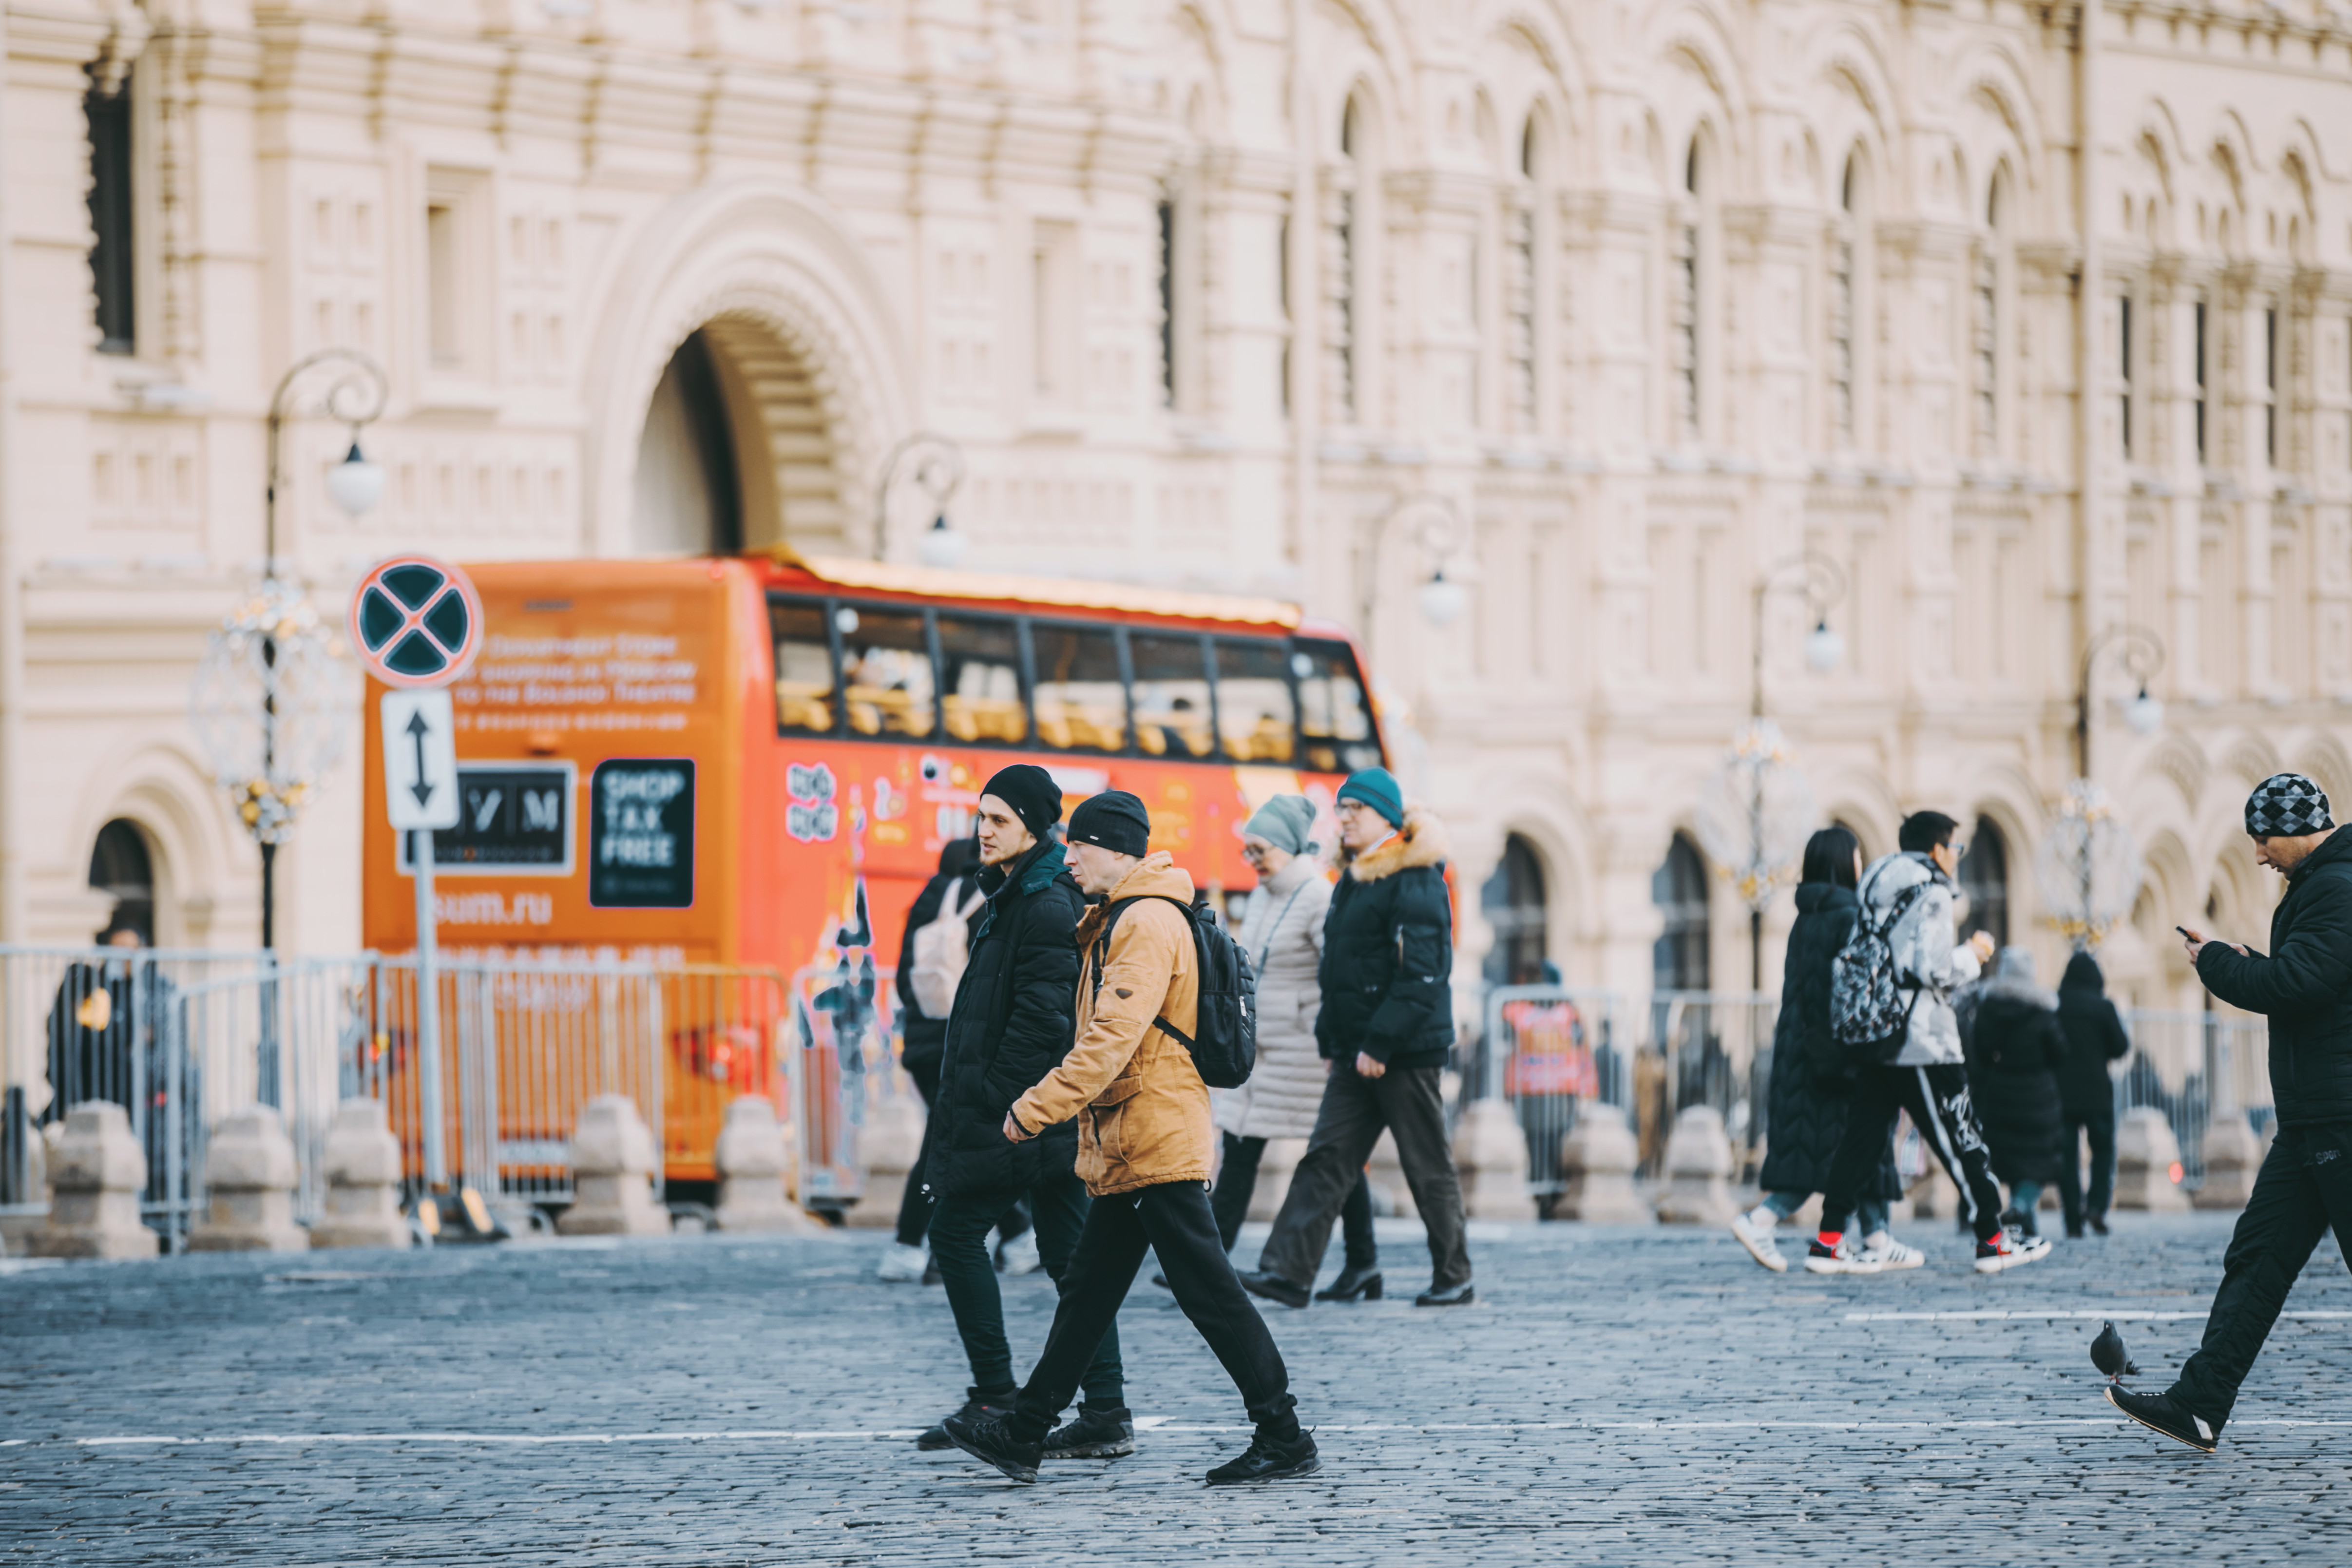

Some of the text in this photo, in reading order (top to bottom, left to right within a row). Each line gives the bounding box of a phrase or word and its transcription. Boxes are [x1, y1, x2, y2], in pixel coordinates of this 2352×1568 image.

[601, 769, 684, 800] SHOP
[468, 788, 559, 832] УМ
[603, 801, 663, 830] TAX
[601, 833, 676, 866] FREE
[433, 893, 553, 924] sum.ru
